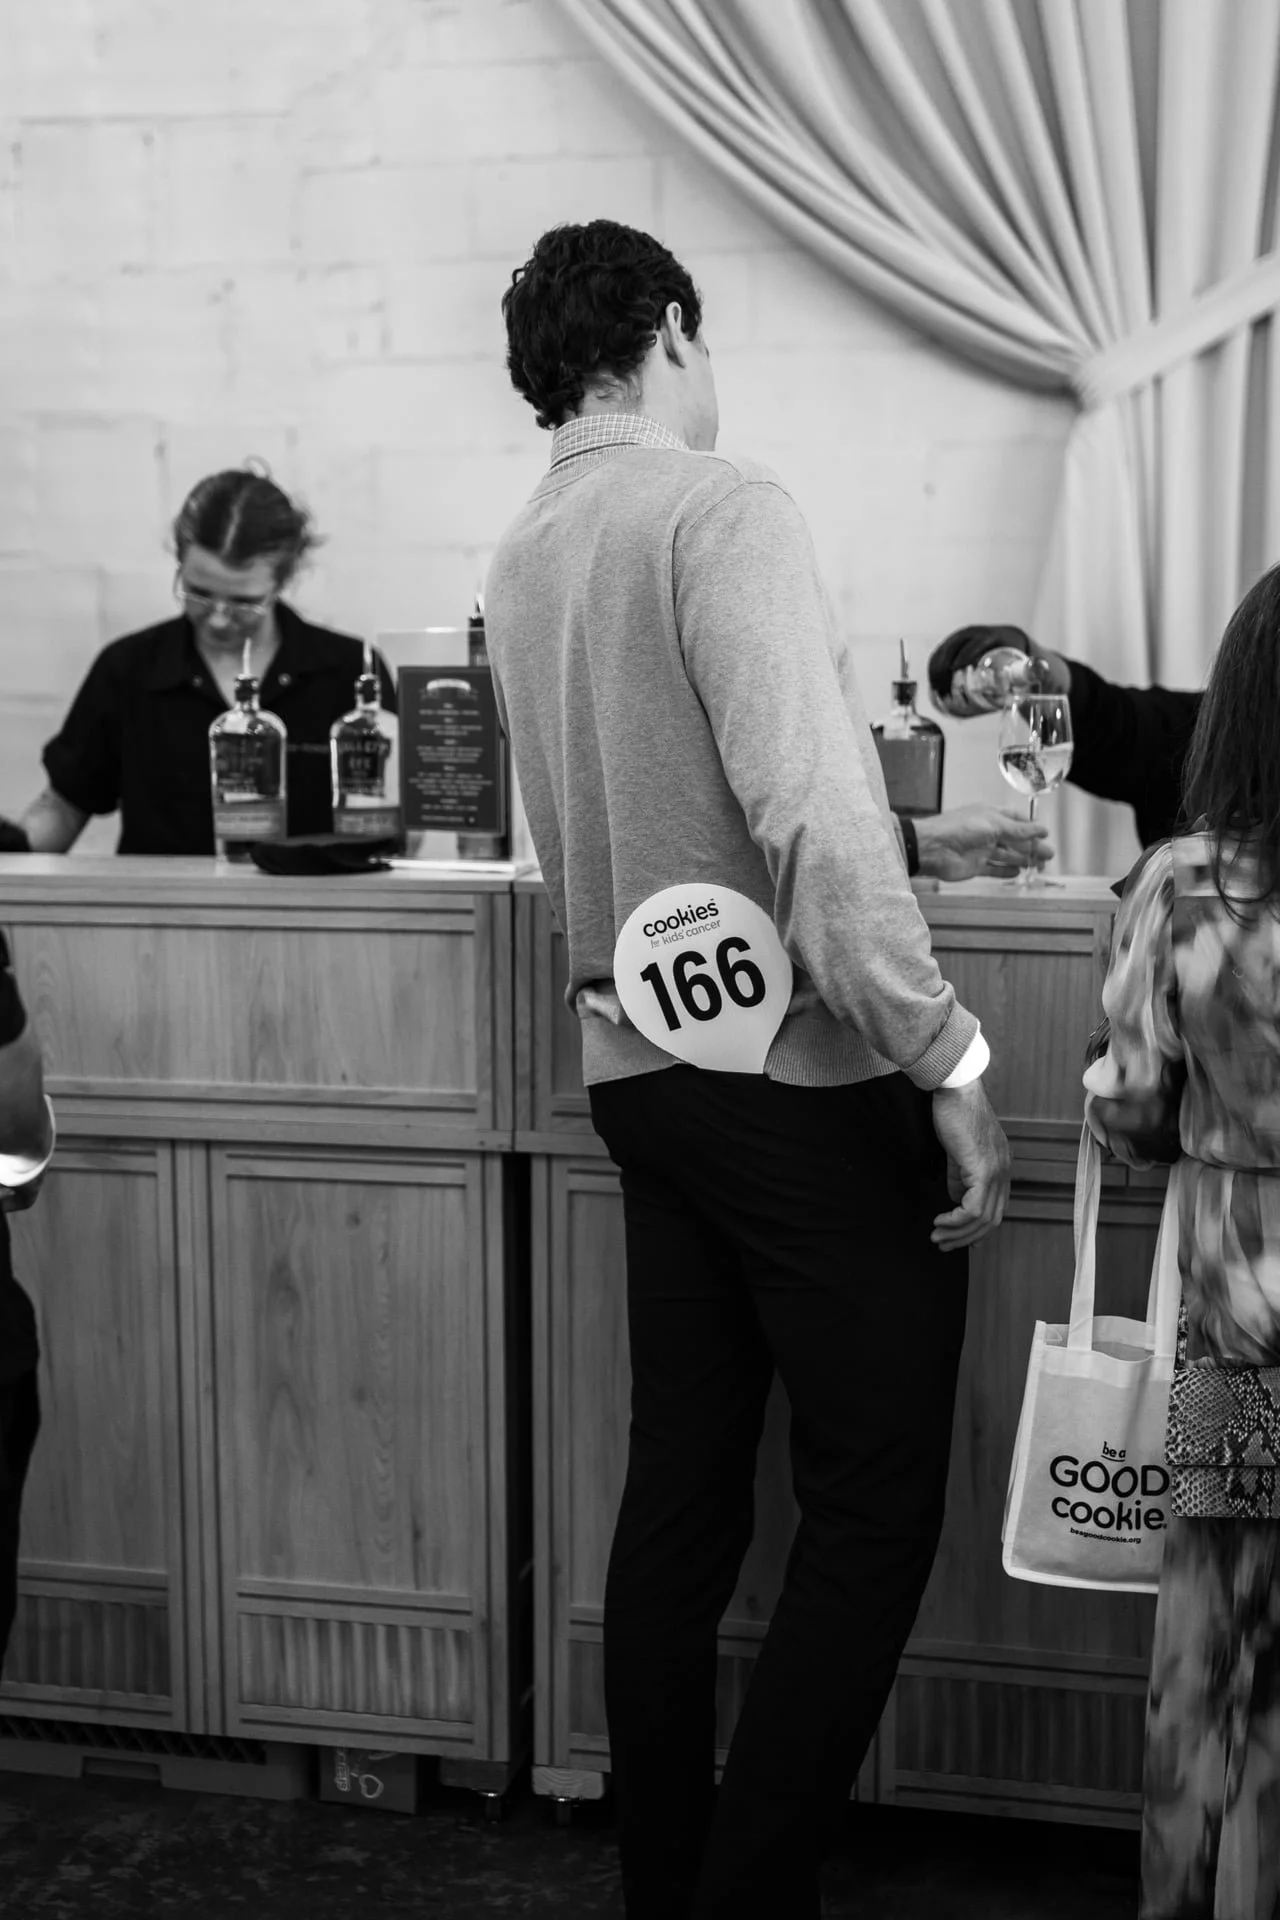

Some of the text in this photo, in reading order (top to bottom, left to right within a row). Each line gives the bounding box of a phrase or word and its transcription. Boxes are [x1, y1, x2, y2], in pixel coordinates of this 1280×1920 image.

[643, 902, 719, 937] cookies
[685, 920, 721, 937] cancer
[640, 936, 767, 1032] 166
[1102, 1441, 1127, 1458] be a
[1049, 1455, 1170, 1498] GOOD
[1070, 1527, 1142, 1545] beagoodcookie.org
